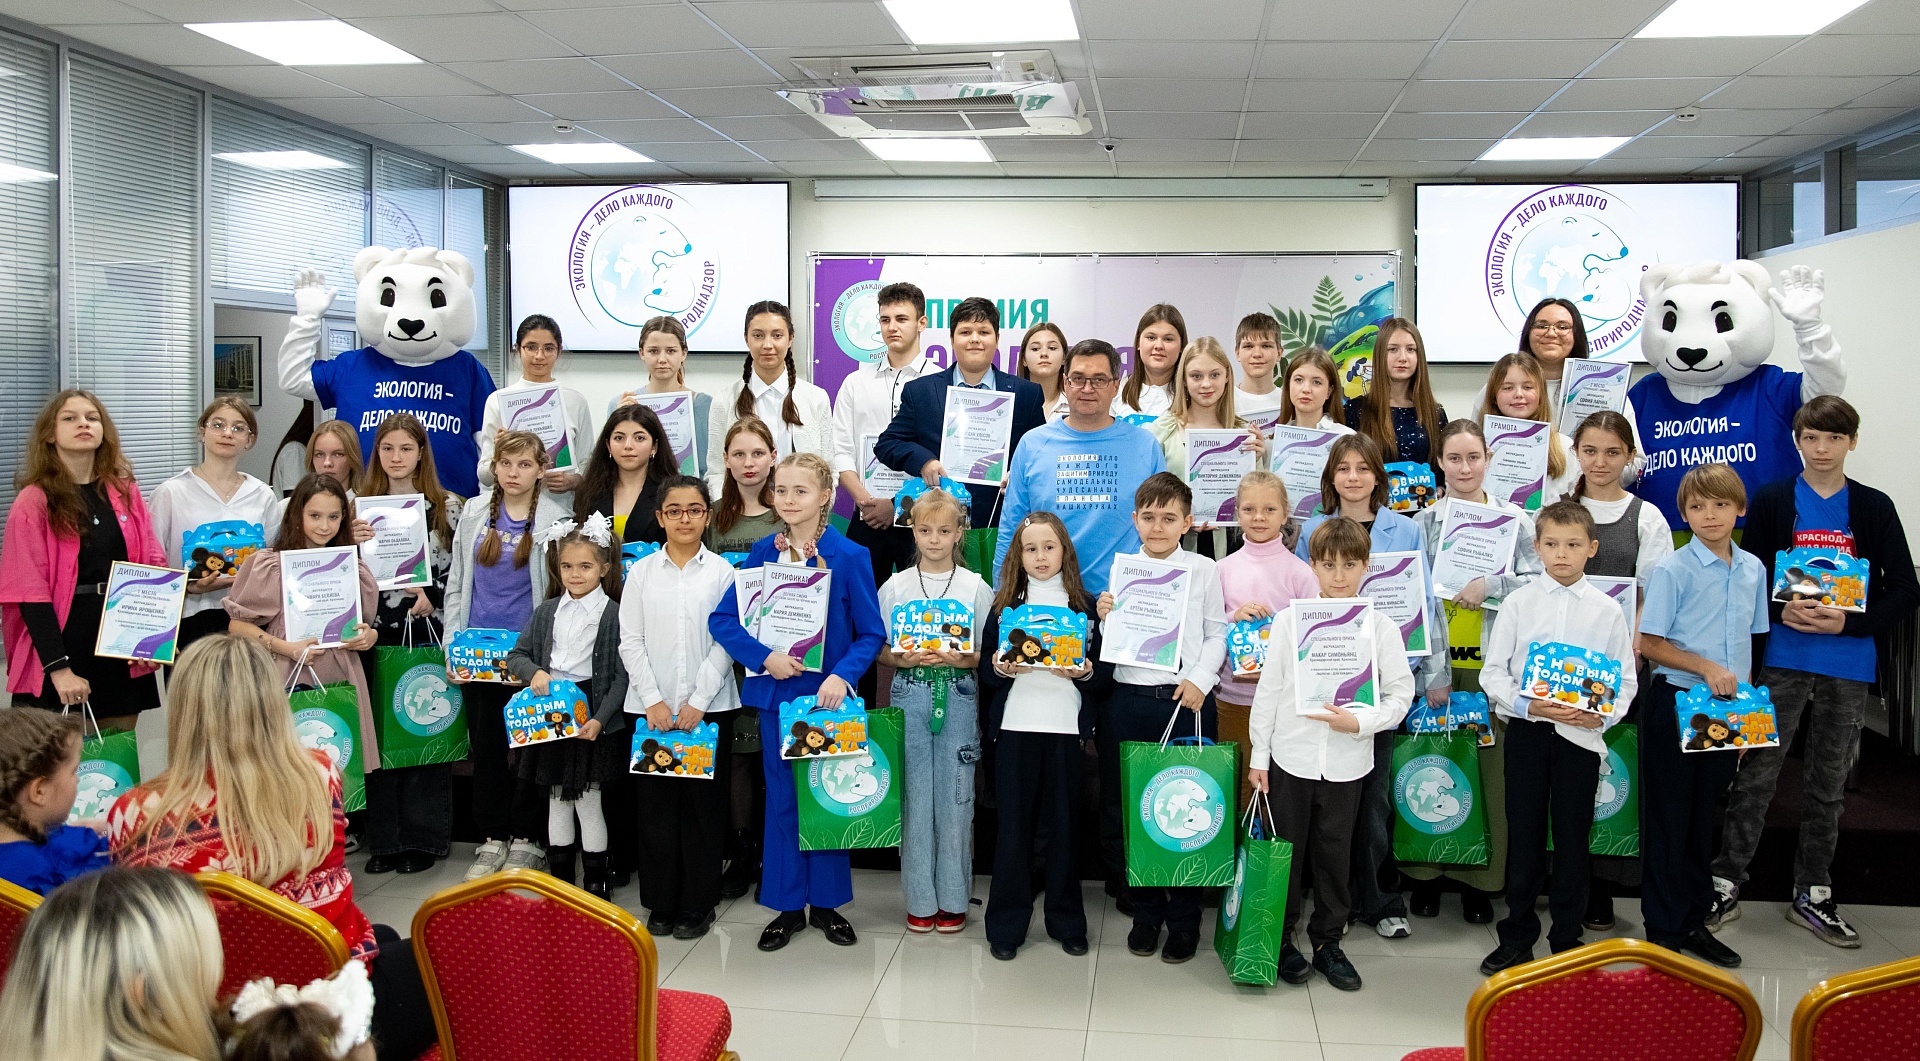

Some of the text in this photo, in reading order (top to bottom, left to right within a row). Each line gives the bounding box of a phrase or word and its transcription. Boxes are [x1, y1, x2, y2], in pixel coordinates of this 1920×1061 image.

[573, 230, 591, 291] ЭКОЛОГИЯ
[594, 199, 620, 226] ДЕЛО
[621, 193, 673, 210] КАЖДОГО
[1491, 232, 1513, 297] ЭКОЛОГИЯ
[1516, 199, 1547, 227] ДЕЛО
[1548, 193, 1608, 211] КАЖДОГО
[681, 261, 715, 329] РОДНАДЗОР
[846, 287, 861, 300] ДЕЛО
[861, 283, 887, 291] КАЖДО
[926, 298, 1049, 330] ПМИЯ
[1576, 363, 1601, 373] ДИПЛОМ
[373, 381, 443, 400] ЭКОЛОГИЯ
[507, 398, 532, 409] ДИПЛОМ
[398, 409, 461, 434] ЖДОГО
[1491, 422, 1518, 432] ГРАМОТА
[1654, 416, 1728, 440] ЭКОЛОГИЯ
[1280, 431, 1308, 441] ГРАМОТА
[1193, 440, 1220, 448] ДИПЛОМ
[1644, 442, 1757, 477] ДЕЛО КАЖДОГО
[1453, 510, 1483, 522] ДИПЛОМ
[1797, 533, 1846, 544] КРАСНОД
[291, 560, 321, 570] ДИПЛОМ
[117, 567, 151, 578] ДИПЛОМ
[770, 571, 809, 583] СЕРТИФИКАТ
[1122, 566, 1153, 578] ДИПЛОМ
[745, 580, 763, 590] ДИПЛ
[897, 611, 969, 623] С НОВЫМ
[1301, 611, 1333, 621] ДИПЛОМ
[1232, 632, 1244, 645] С
[452, 646, 461, 657] С
[454, 657, 493, 667] ГОДОМ
[1533, 654, 1617, 685] С НОВЫМ
[1532, 665, 1585, 688] ГОДОМ
[507, 706, 515, 719] С
[517, 700, 566, 718] НОВЫМ
[509, 715, 546, 729] ГОДОМ
[1411, 718, 1422, 728] С
[76, 762, 106, 774] АЖДОГО
[809, 757, 821, 787] ЭКОЛОГ
[1170, 767, 1200, 778] КАЖДОГО
[1593, 778, 1628, 819] СПРИРОДНАДЗОР
